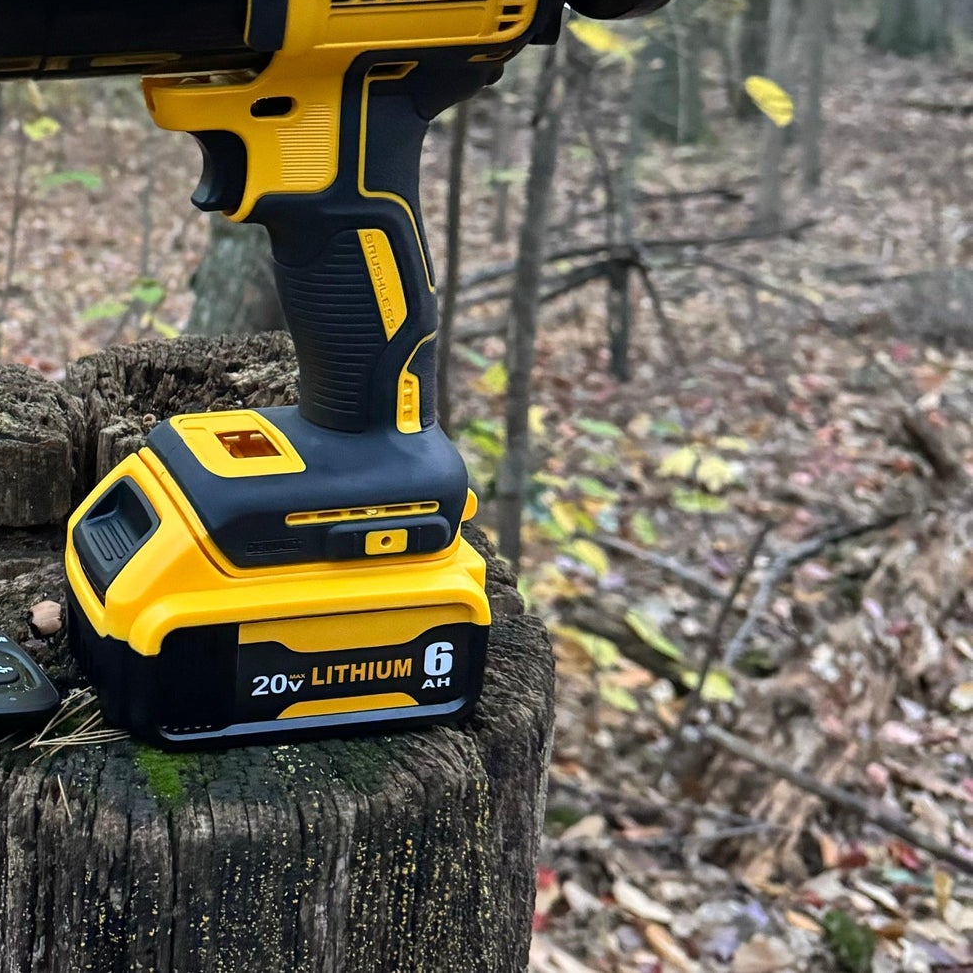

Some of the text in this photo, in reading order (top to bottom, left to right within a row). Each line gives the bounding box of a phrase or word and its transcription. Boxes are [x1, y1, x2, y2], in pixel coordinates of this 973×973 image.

[364, 233, 396, 330] BRUSHLESS
[311, 658, 413, 686] LITHIUM
[423, 641, 454, 676] 6
[421, 677, 451, 690] AH
